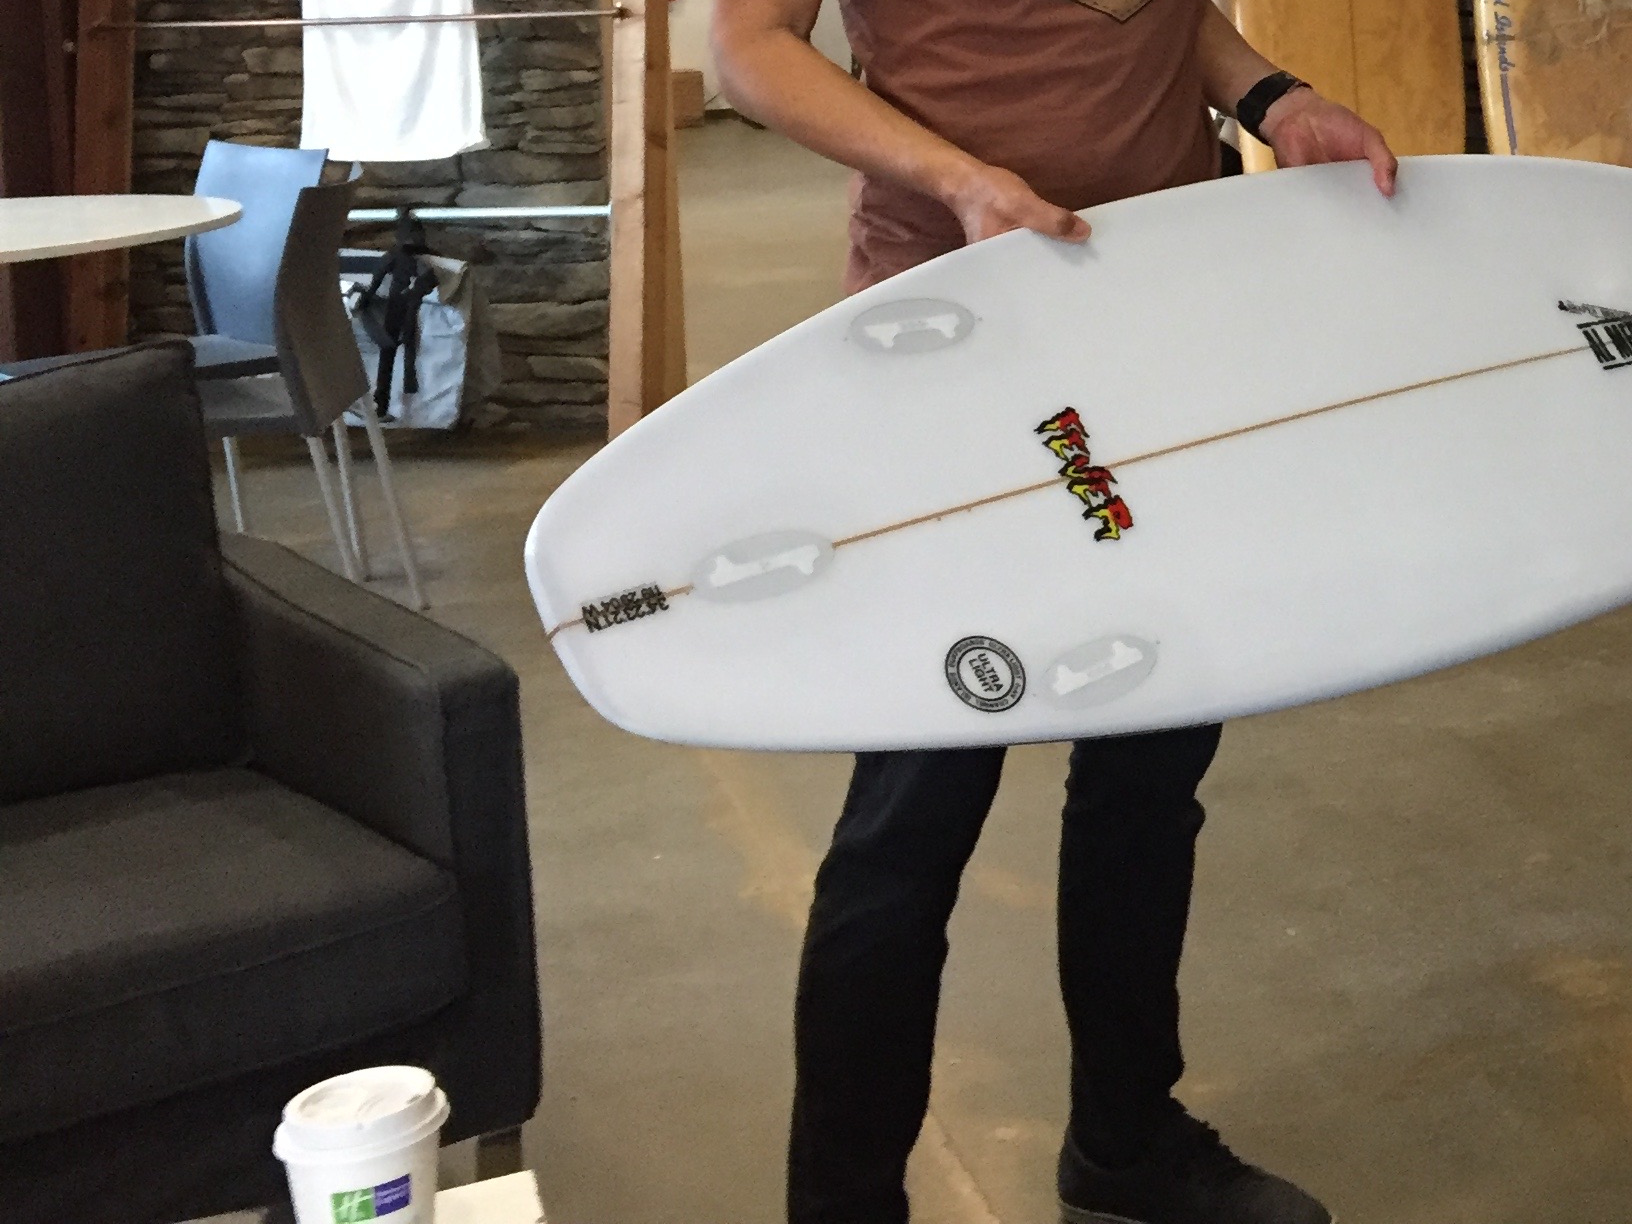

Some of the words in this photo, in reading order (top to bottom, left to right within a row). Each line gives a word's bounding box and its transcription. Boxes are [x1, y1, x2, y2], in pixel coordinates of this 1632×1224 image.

[1034, 406, 1134, 542] FEVER
[968, 657, 995, 693] LIGHT
[978, 652, 1004, 693] ULTRA
